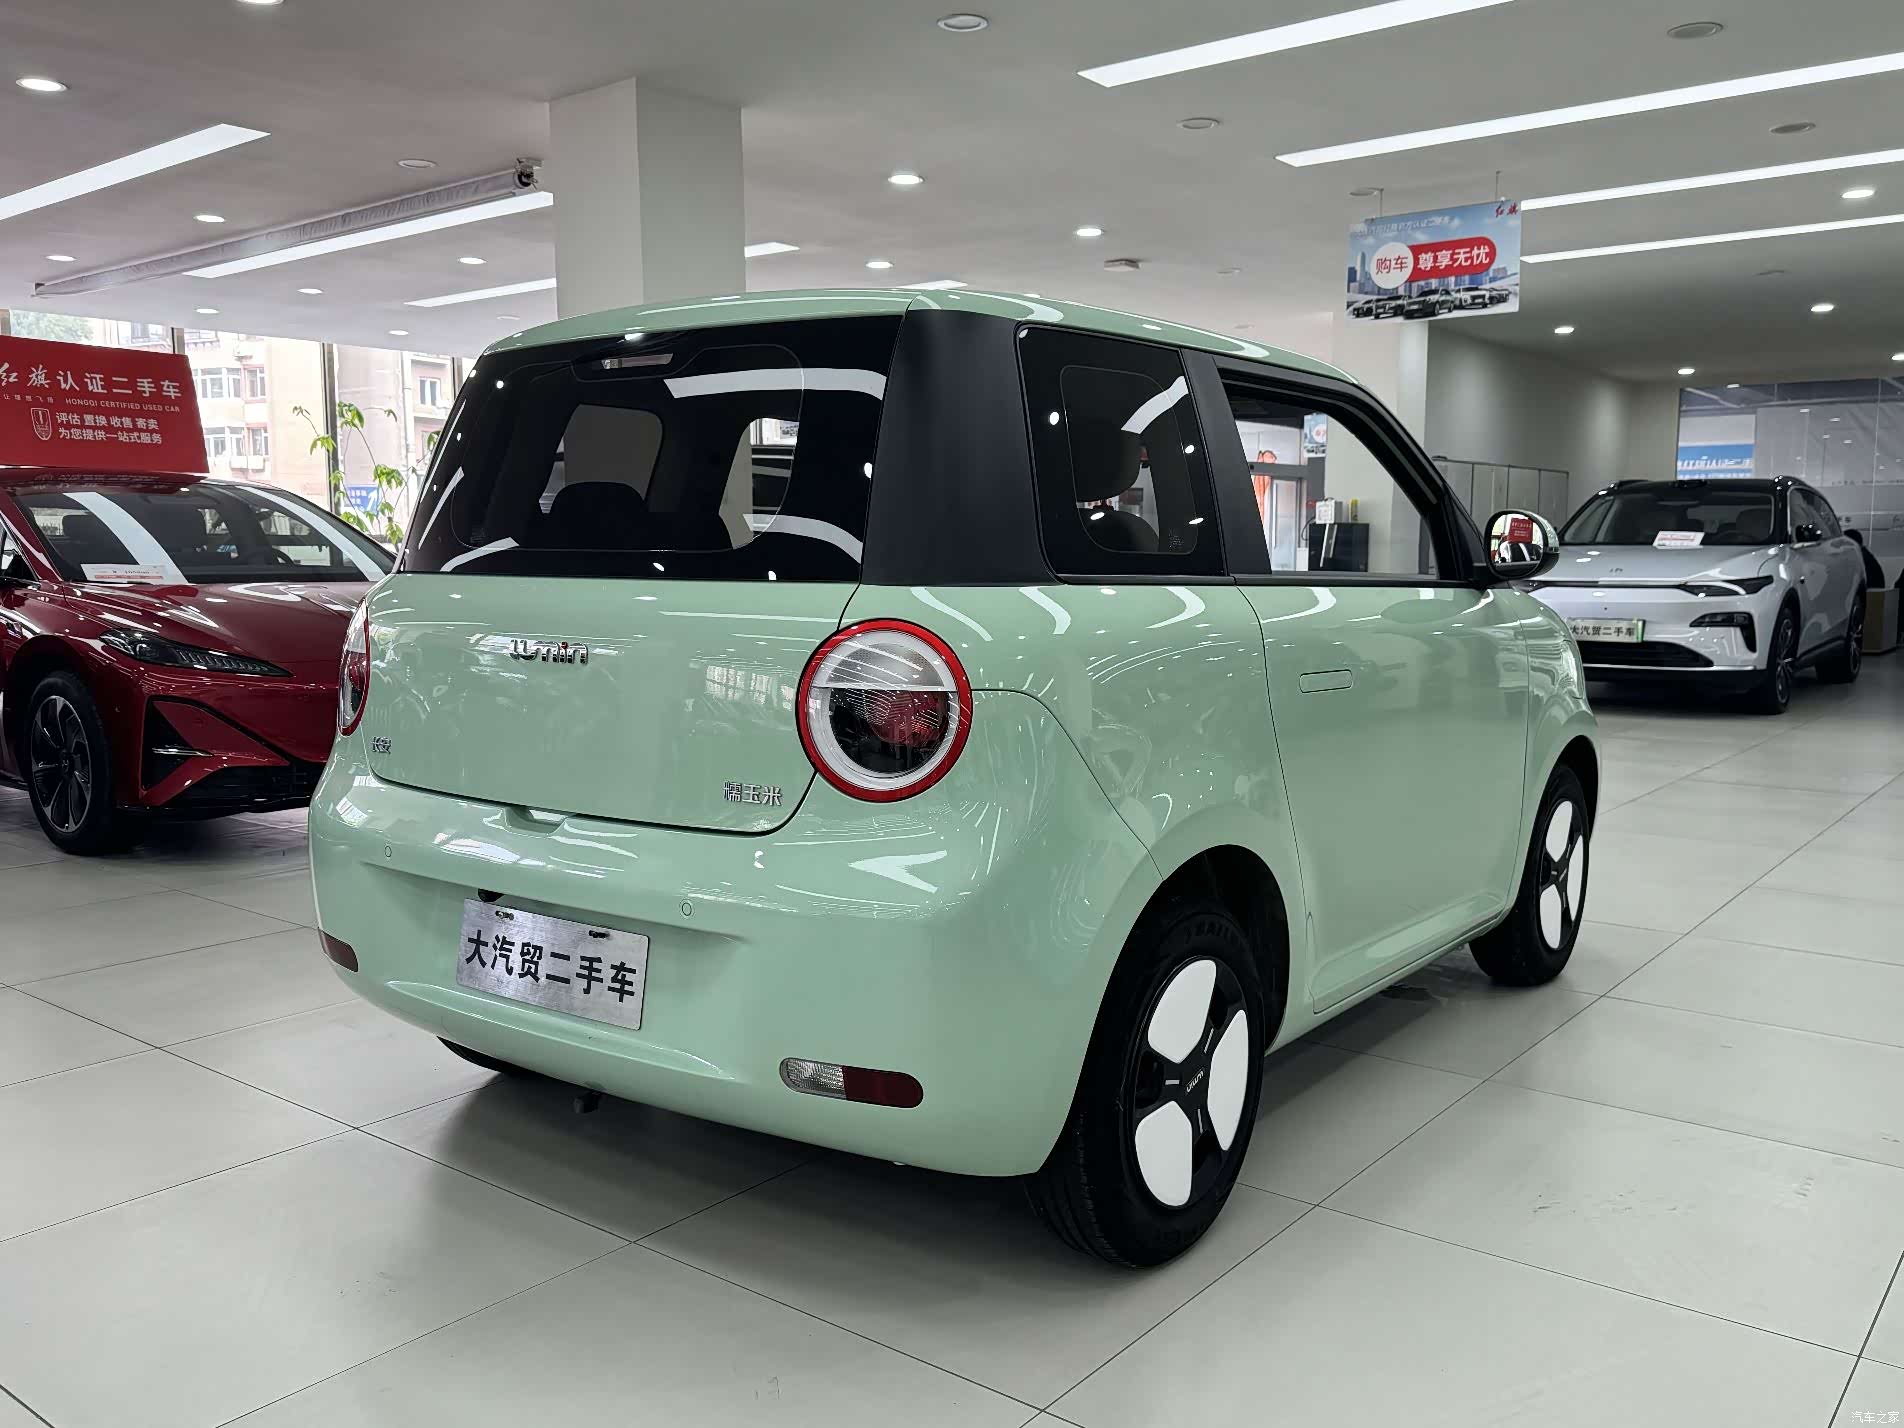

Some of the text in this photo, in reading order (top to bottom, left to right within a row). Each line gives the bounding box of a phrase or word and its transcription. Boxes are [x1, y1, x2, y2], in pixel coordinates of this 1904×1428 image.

[1375, 245, 1490, 275] 购车 尊享无忧
[0, 362, 182, 399] 红旗认证二手车
[65, 398, 98, 406] HONGQI
[100, 401, 140, 410] CERTIFIED
[142, 404, 163, 412] USED
[56, 412, 159, 430] 评估 置换 收售 寄卖
[58, 427, 162, 445] 为您提供一站式服务
[723, 780, 782, 806] 糯玉米
[465, 929, 637, 1003] 大汽贸二手车
